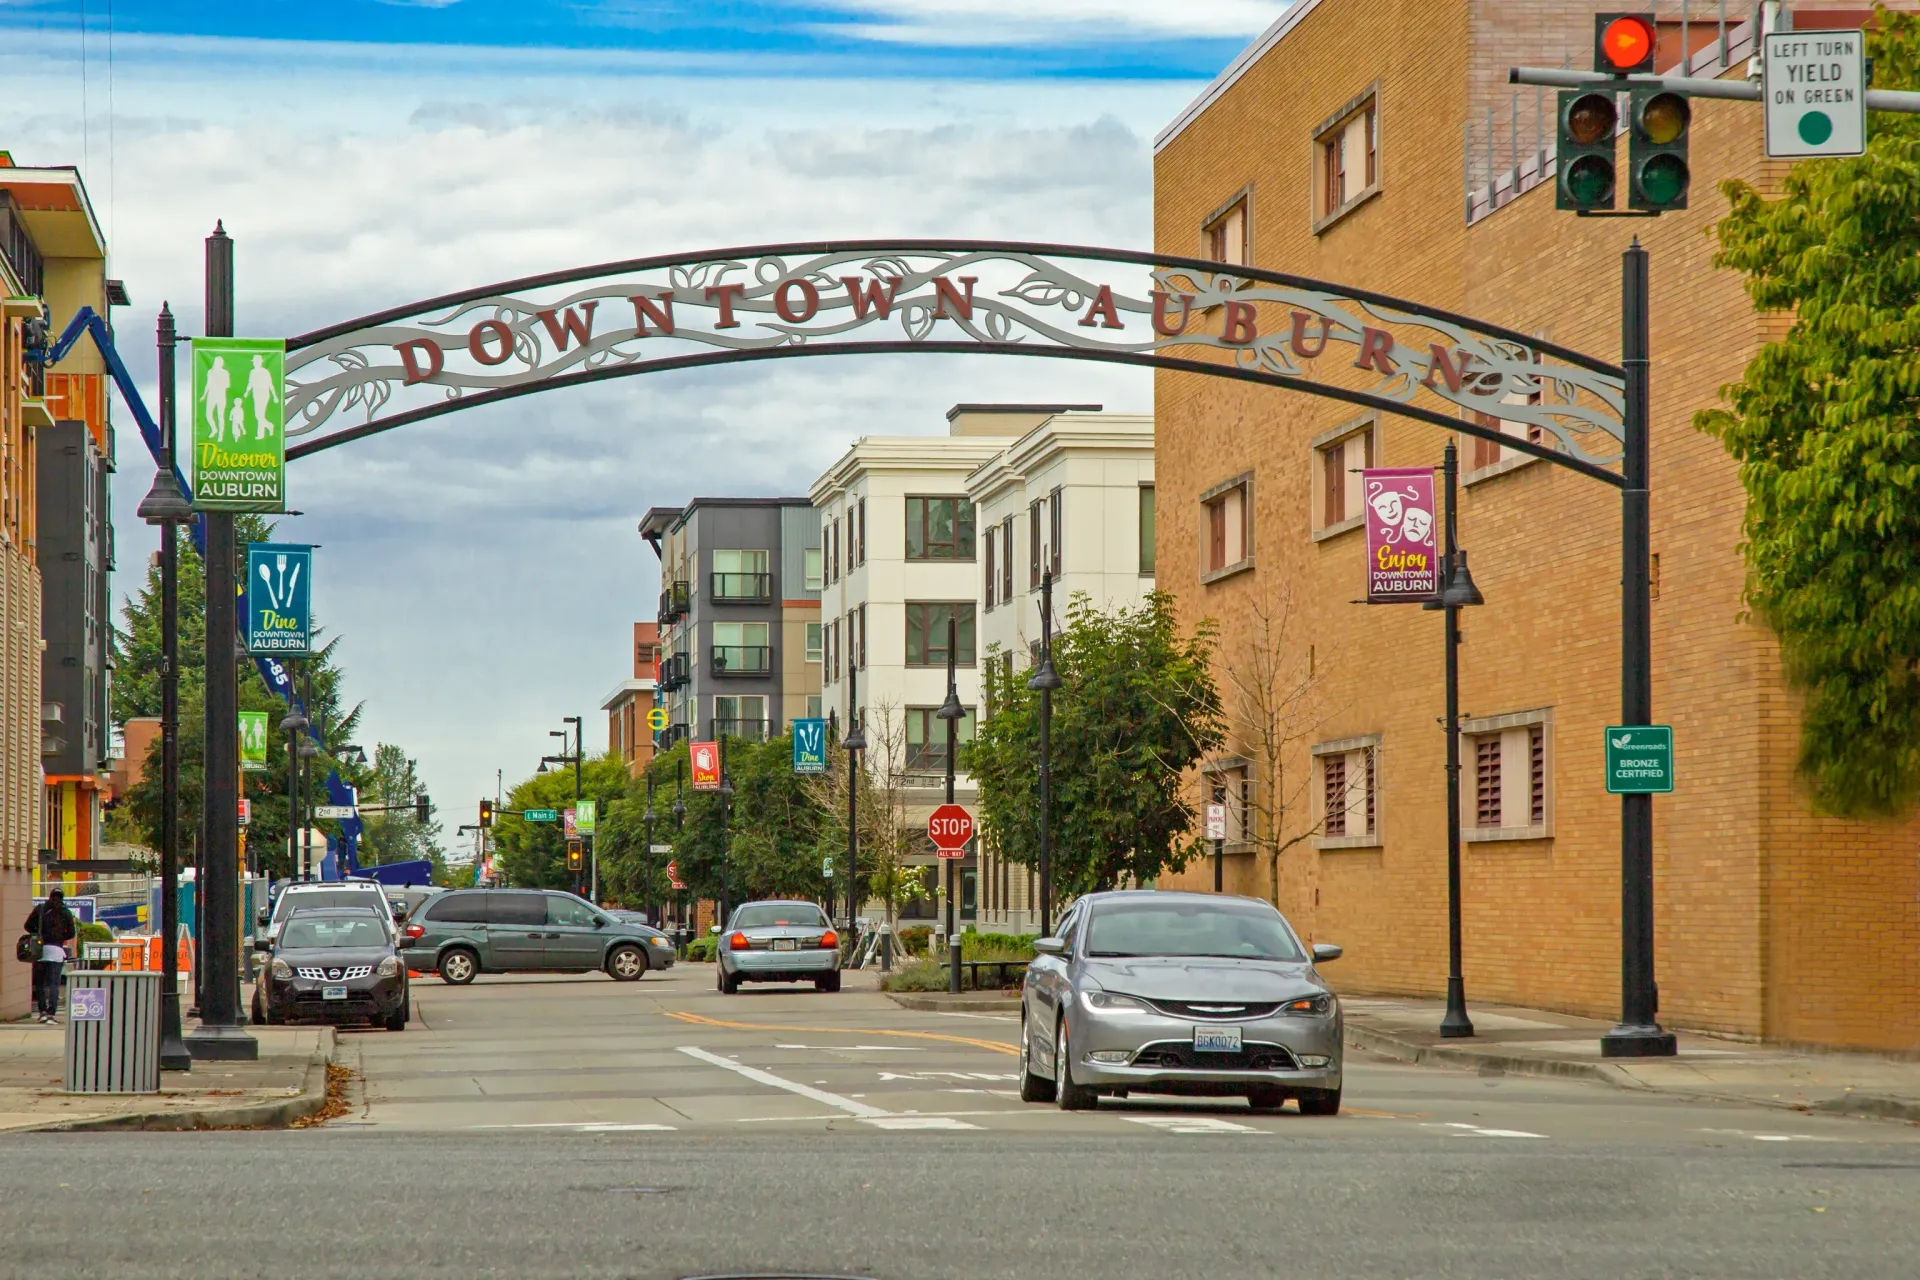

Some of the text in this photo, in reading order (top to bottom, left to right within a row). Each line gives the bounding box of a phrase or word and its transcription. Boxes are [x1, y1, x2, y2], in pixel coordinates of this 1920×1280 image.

[1774, 42, 1854, 57] LEFT TURN
[1786, 64, 1842, 82] YIELD
[1775, 88, 1854, 104] ON GREEN
[393, 276, 1471, 392] DOWNTOWN AUBURN
[197, 442, 278, 468] Discover
[200, 471, 276, 480] DOWNTOWN
[199, 483, 277, 497] AUBURN
[1377, 544, 1427, 573] Enjoy
[1374, 570, 1432, 580] DOWNTOWN
[1373, 580, 1432, 592] AUBURN
[260, 610, 298, 630] Dine
[253, 639, 305, 648] AUBURN
[265, 658, 289, 685] -85
[800, 752, 820, 762] Dine
[1620, 760, 1660, 768] BRONZE
[698, 772, 715, 782] Shop
[1616, 770, 1664, 778] CERTIFIED
[901, 778, 914, 786] 2nd
[318, 808, 330, 816] 2nd
[931, 818, 970, 835] STOP
